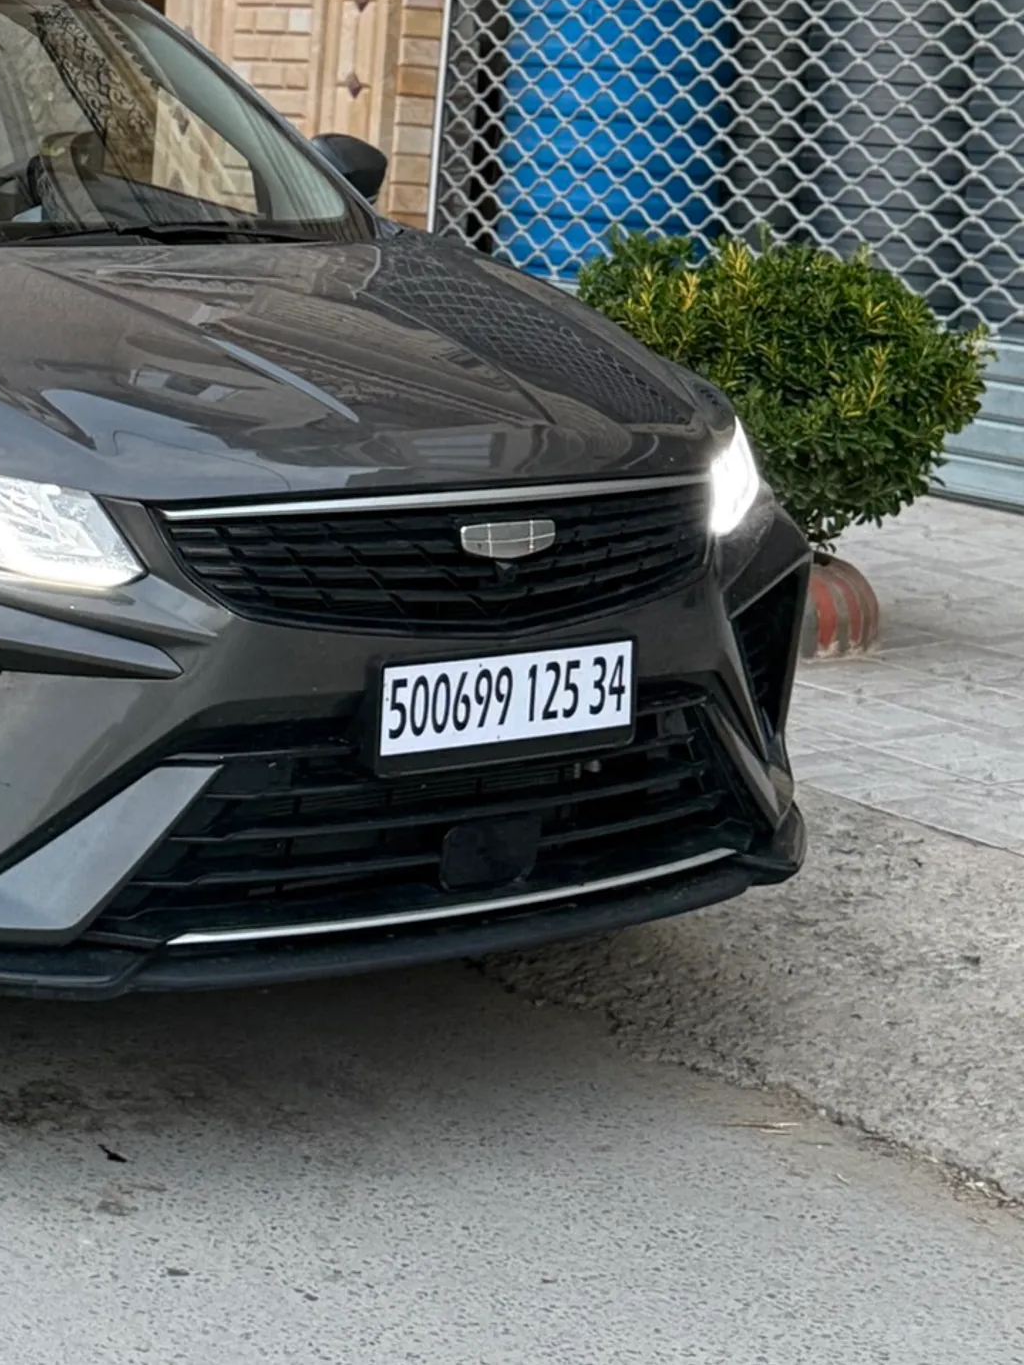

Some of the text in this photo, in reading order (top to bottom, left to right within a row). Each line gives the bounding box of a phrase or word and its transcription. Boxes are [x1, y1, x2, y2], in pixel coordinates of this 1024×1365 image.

[388, 655, 626, 739] 500699 125 34
